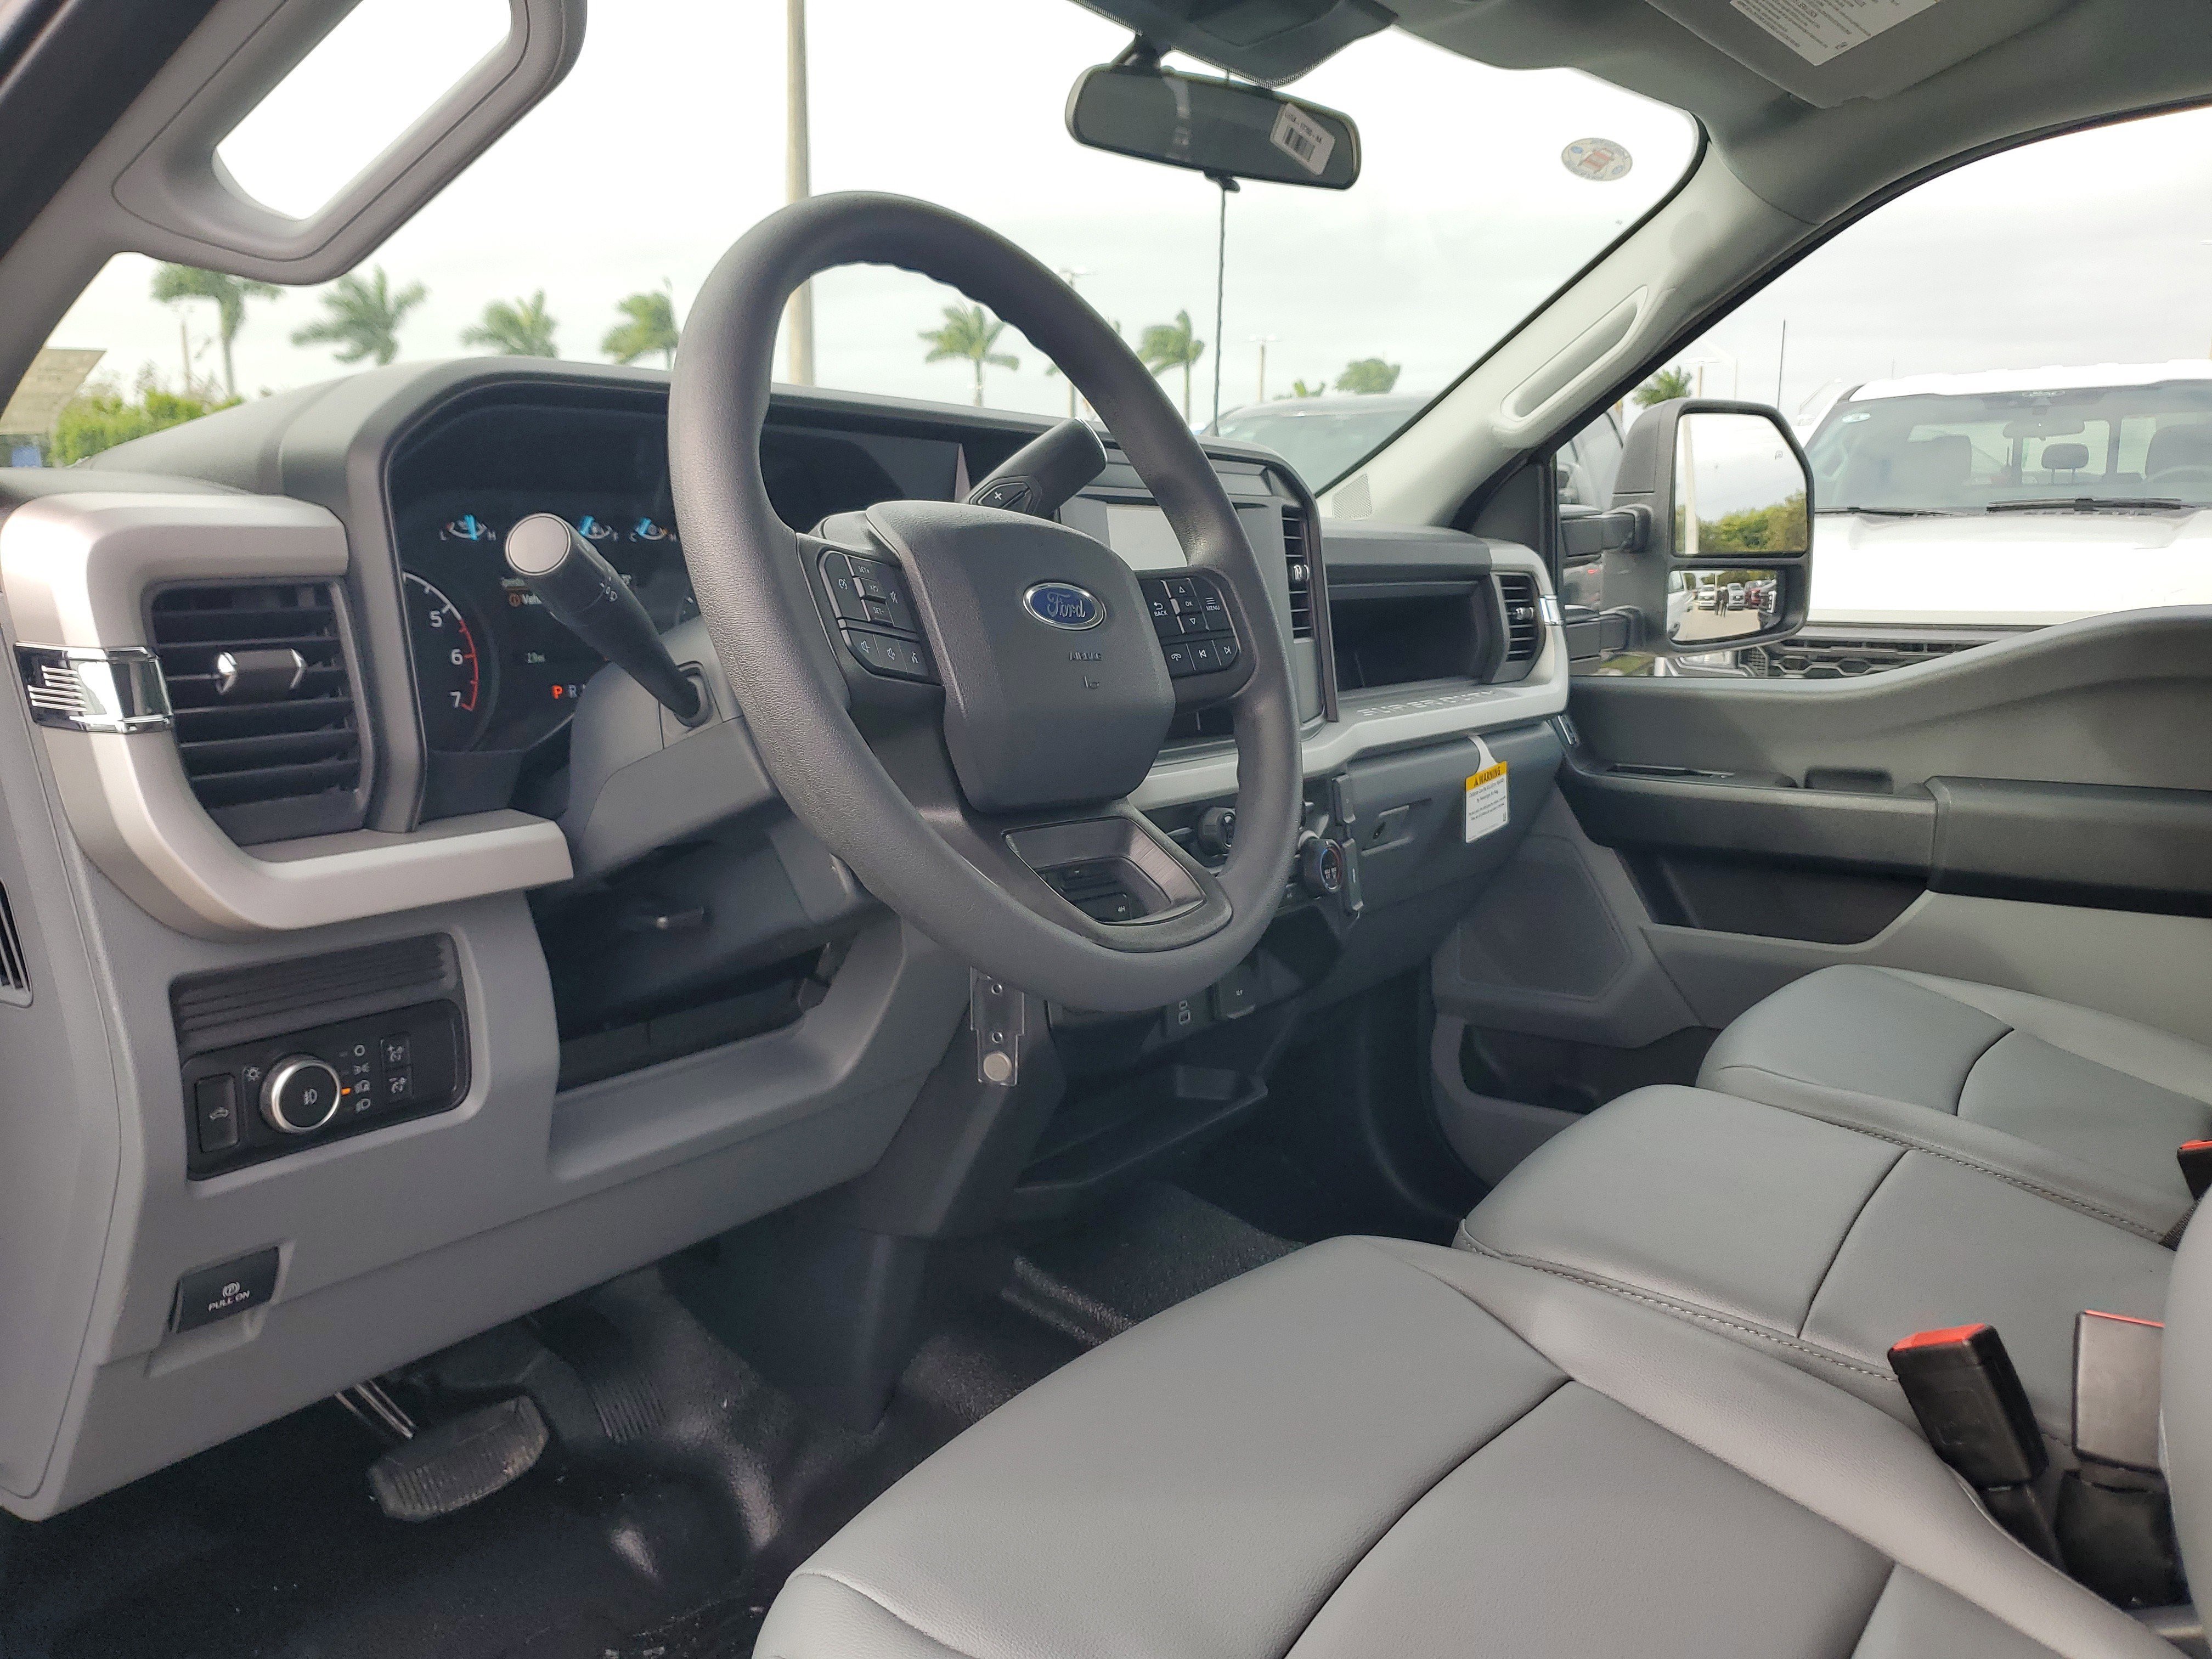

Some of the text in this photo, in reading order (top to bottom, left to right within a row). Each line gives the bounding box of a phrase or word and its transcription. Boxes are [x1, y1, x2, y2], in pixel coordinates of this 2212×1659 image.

[1046, 591, 1087, 619] Ford
[1154, 608, 1169, 617] BACK
[428, 610, 443, 628] 5
[451, 648, 464, 665] 6
[449, 691, 461, 708] 7
[551, 684, 577, 699] P R
[1479, 766, 1501, 785] WARNING
[207, 1290, 251, 1312] PULL ON
